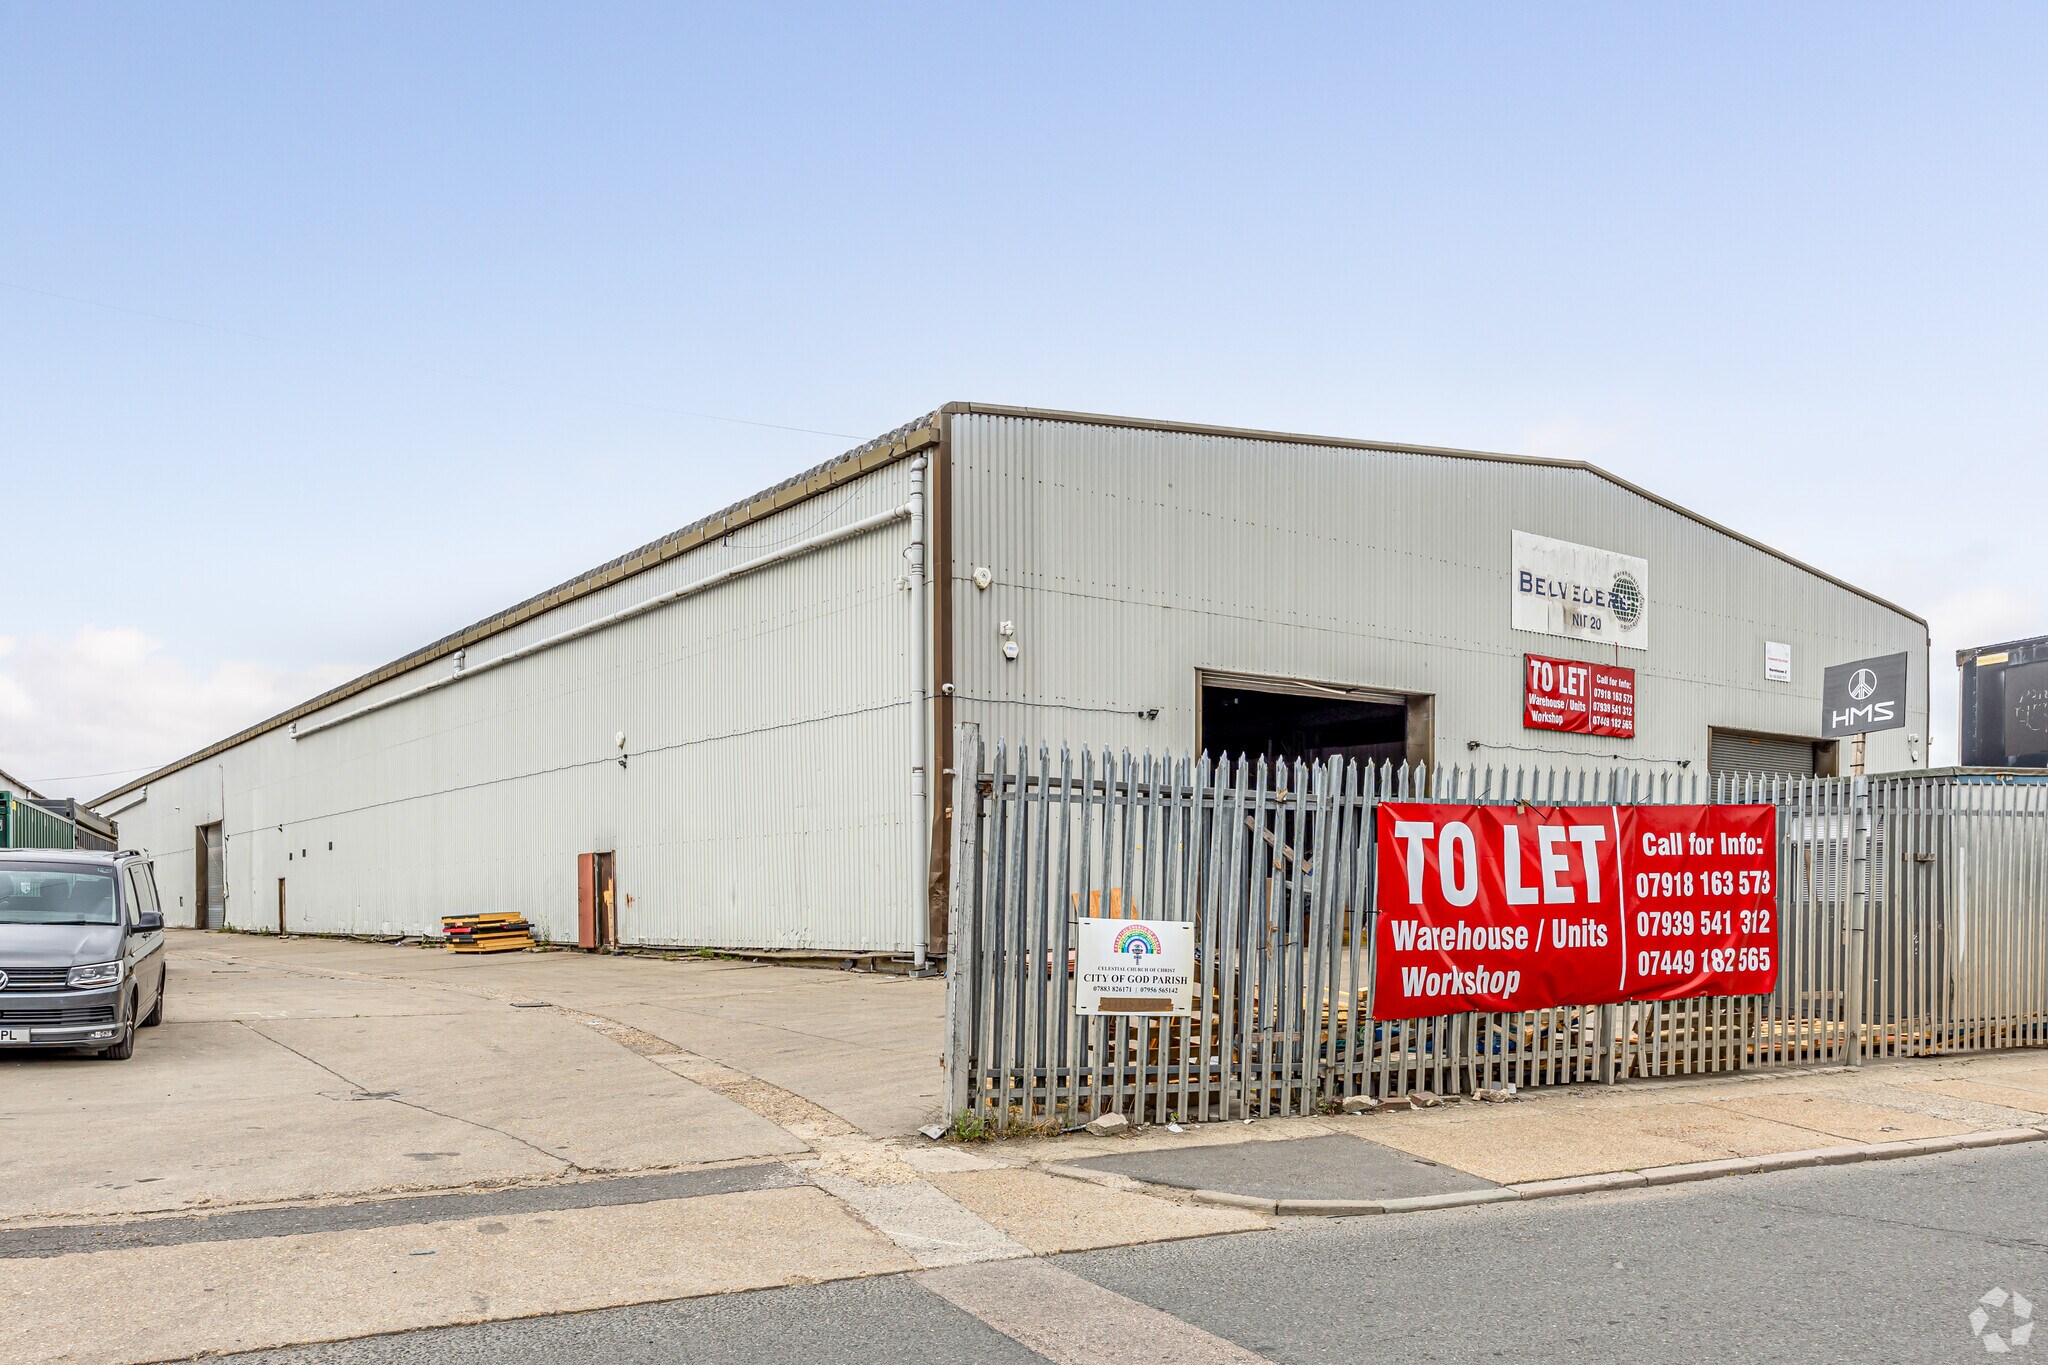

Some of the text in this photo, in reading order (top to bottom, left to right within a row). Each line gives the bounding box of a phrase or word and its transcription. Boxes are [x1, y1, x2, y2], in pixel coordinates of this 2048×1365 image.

[1590, 616, 1602, 630] 20
[1530, 660, 1588, 697] TO LET
[1596, 674, 1632, 690] Call for Info:
[1528, 693, 1586, 712] Warehouse / Units
[1593, 688, 1633, 704] 07918 163 573
[1531, 709, 1563, 726] Workshop
[1593, 701, 1632, 716] 07939 541 312
[1832, 700, 1895, 729] HMS
[1592, 715, 1633, 730] 07449 182 565
[1642, 832, 1763, 857] Call for Info:
[1395, 820, 1606, 907] TO LET
[1636, 870, 1770, 898] 07918 163 573
[1637, 909, 1770, 937] 07939 541 312
[1391, 917, 1608, 952] Warehouse / Units
[1637, 947, 1770, 977] 07449 182 565
[1083, 973, 1188, 985] CITY OF GOD PARISH
[1402, 965, 1521, 999] Workshop
[1, 1030, 17, 1040] PL
